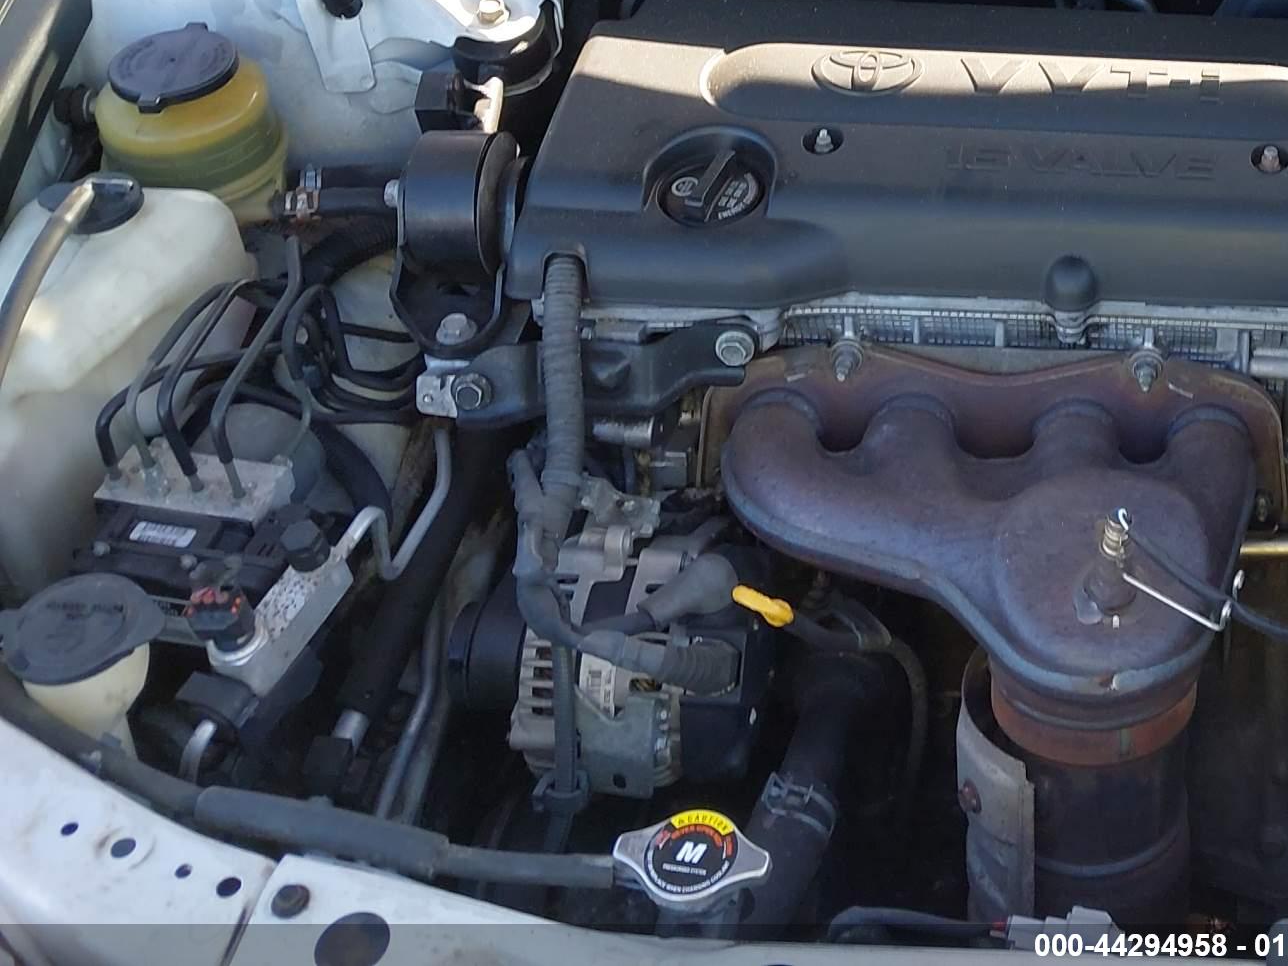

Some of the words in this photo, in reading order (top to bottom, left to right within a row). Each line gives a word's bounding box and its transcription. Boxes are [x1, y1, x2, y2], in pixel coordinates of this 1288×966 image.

[1026, 148, 1216, 179] VALVE
[686, 812, 729, 832] CAUTION
[676, 841, 708, 863] M
